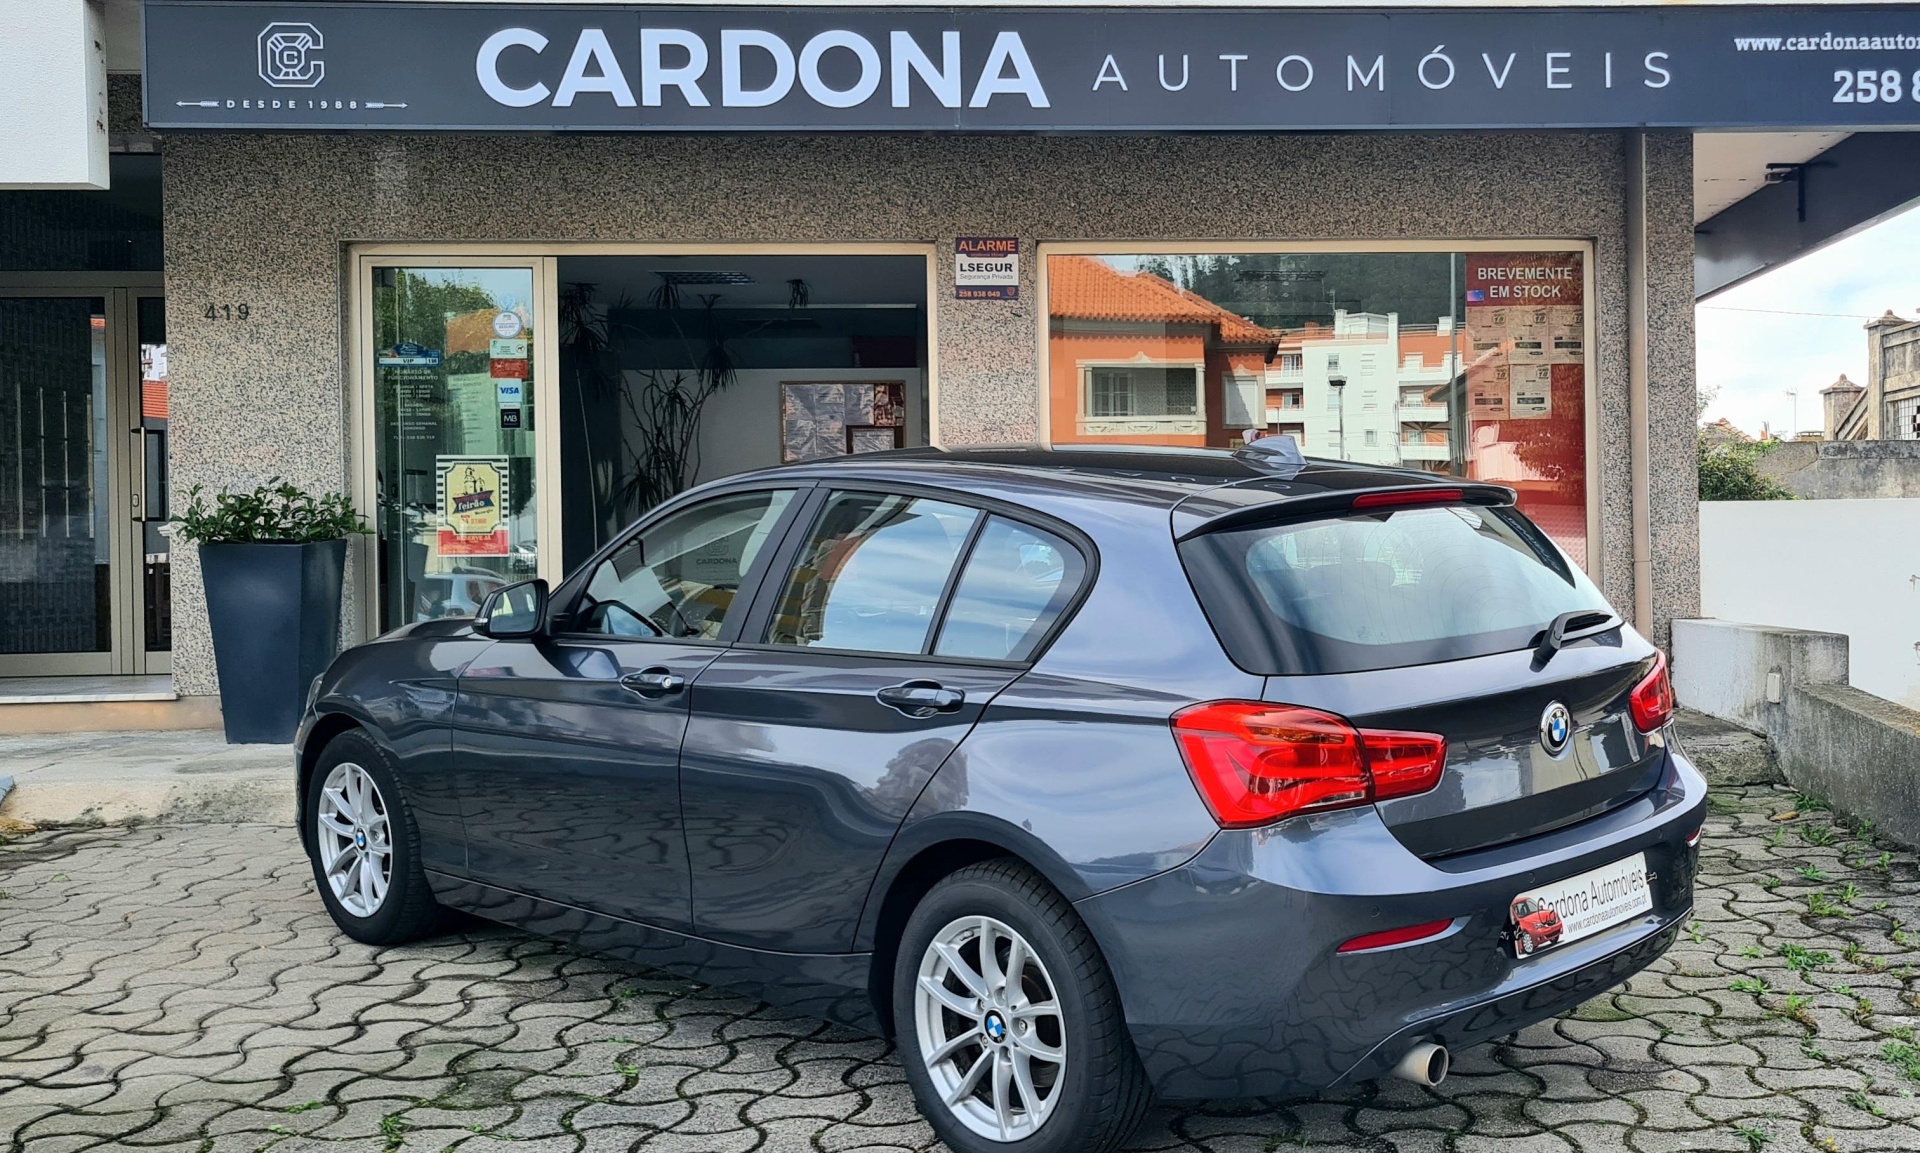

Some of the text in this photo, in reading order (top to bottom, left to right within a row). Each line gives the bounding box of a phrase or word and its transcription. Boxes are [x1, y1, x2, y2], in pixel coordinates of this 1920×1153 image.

[476, 27, 1671, 109] CARDONA AUTOMÓVEIS
[1832, 70, 1902, 103] 258
[226, 100, 357, 110] DESDE 1988
[959, 240, 1016, 251] ALARME
[960, 263, 1013, 272] LSEGUR
[1478, 267, 1573, 280] BREVEMENTE
[1489, 285, 1561, 298] EM STOCK
[204, 303, 250, 321] 419
[503, 414, 518, 422] MB
[696, 557, 738, 565] CARDONA
[1537, 863, 1644, 926] Cardona Automóveis
